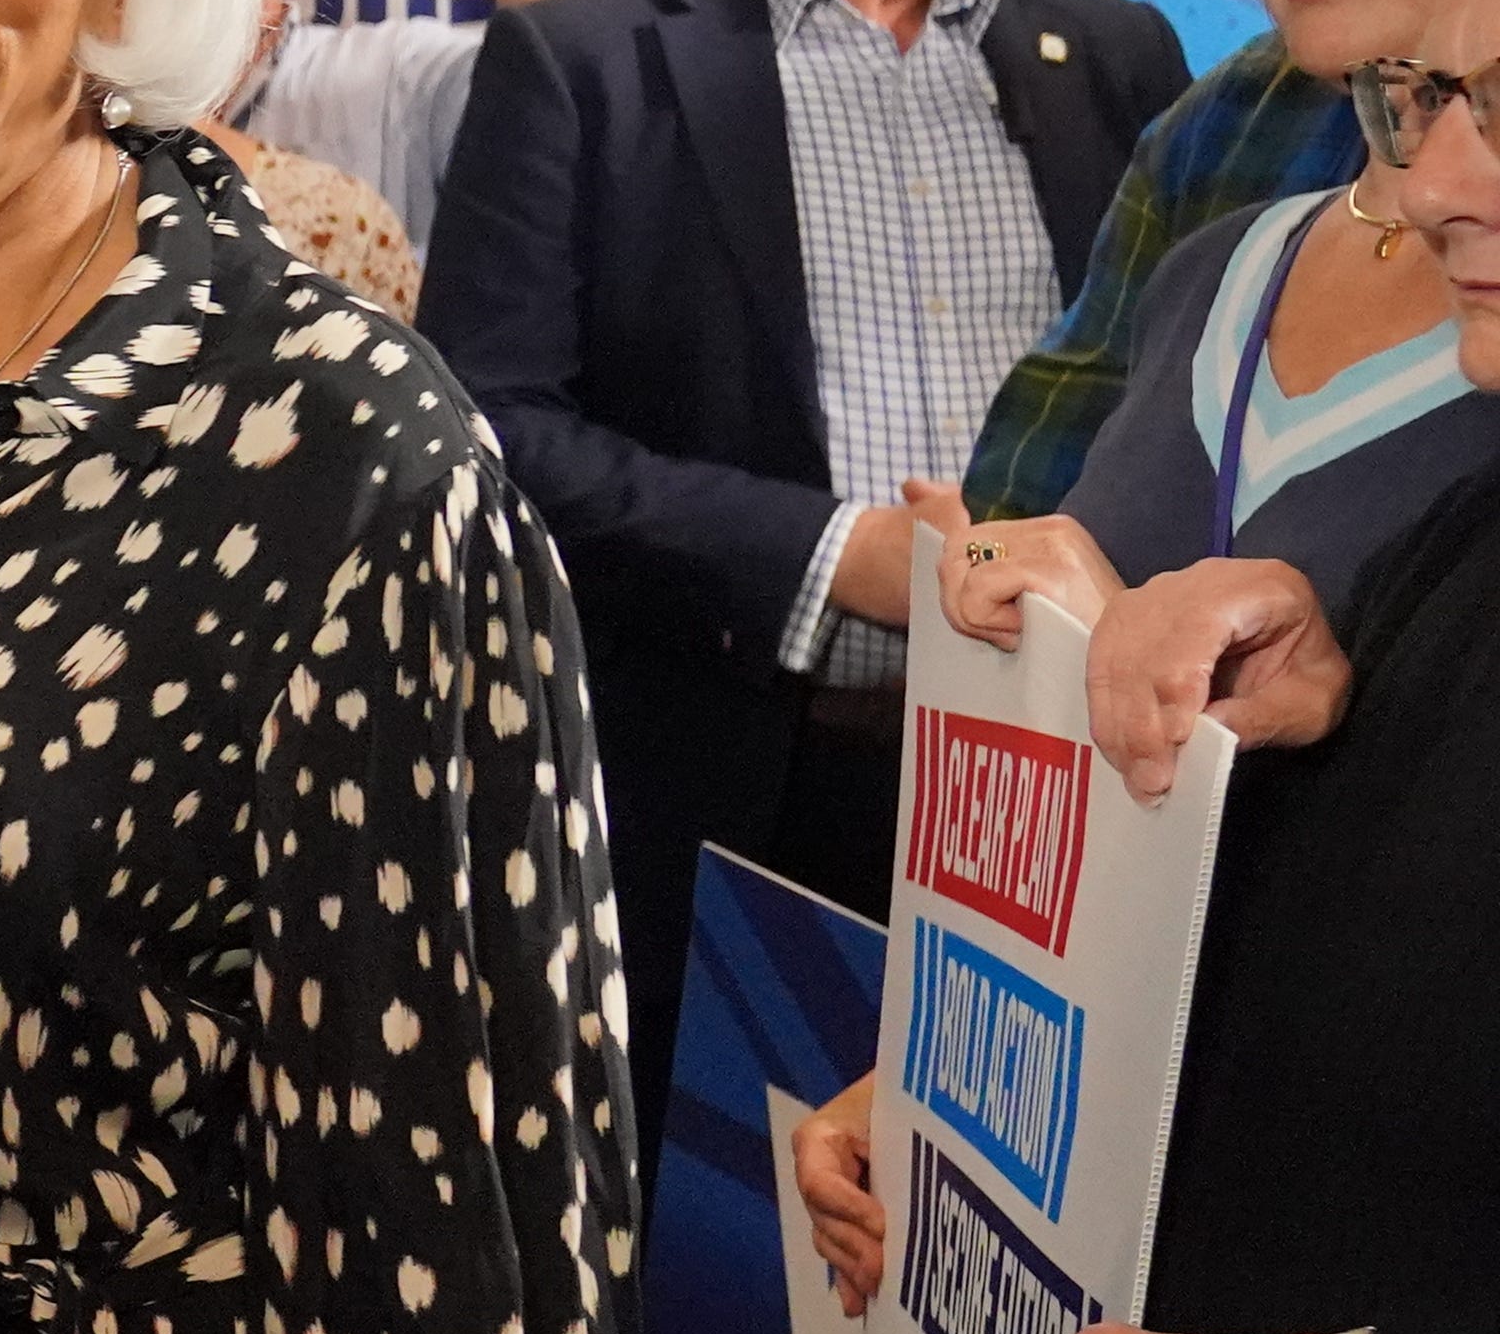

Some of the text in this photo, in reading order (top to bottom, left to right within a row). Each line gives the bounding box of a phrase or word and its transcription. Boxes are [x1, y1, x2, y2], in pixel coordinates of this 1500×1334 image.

[941, 737, 1069, 920] CLEAR PLAN
[937, 955, 1062, 1180] BOLD ACTION
